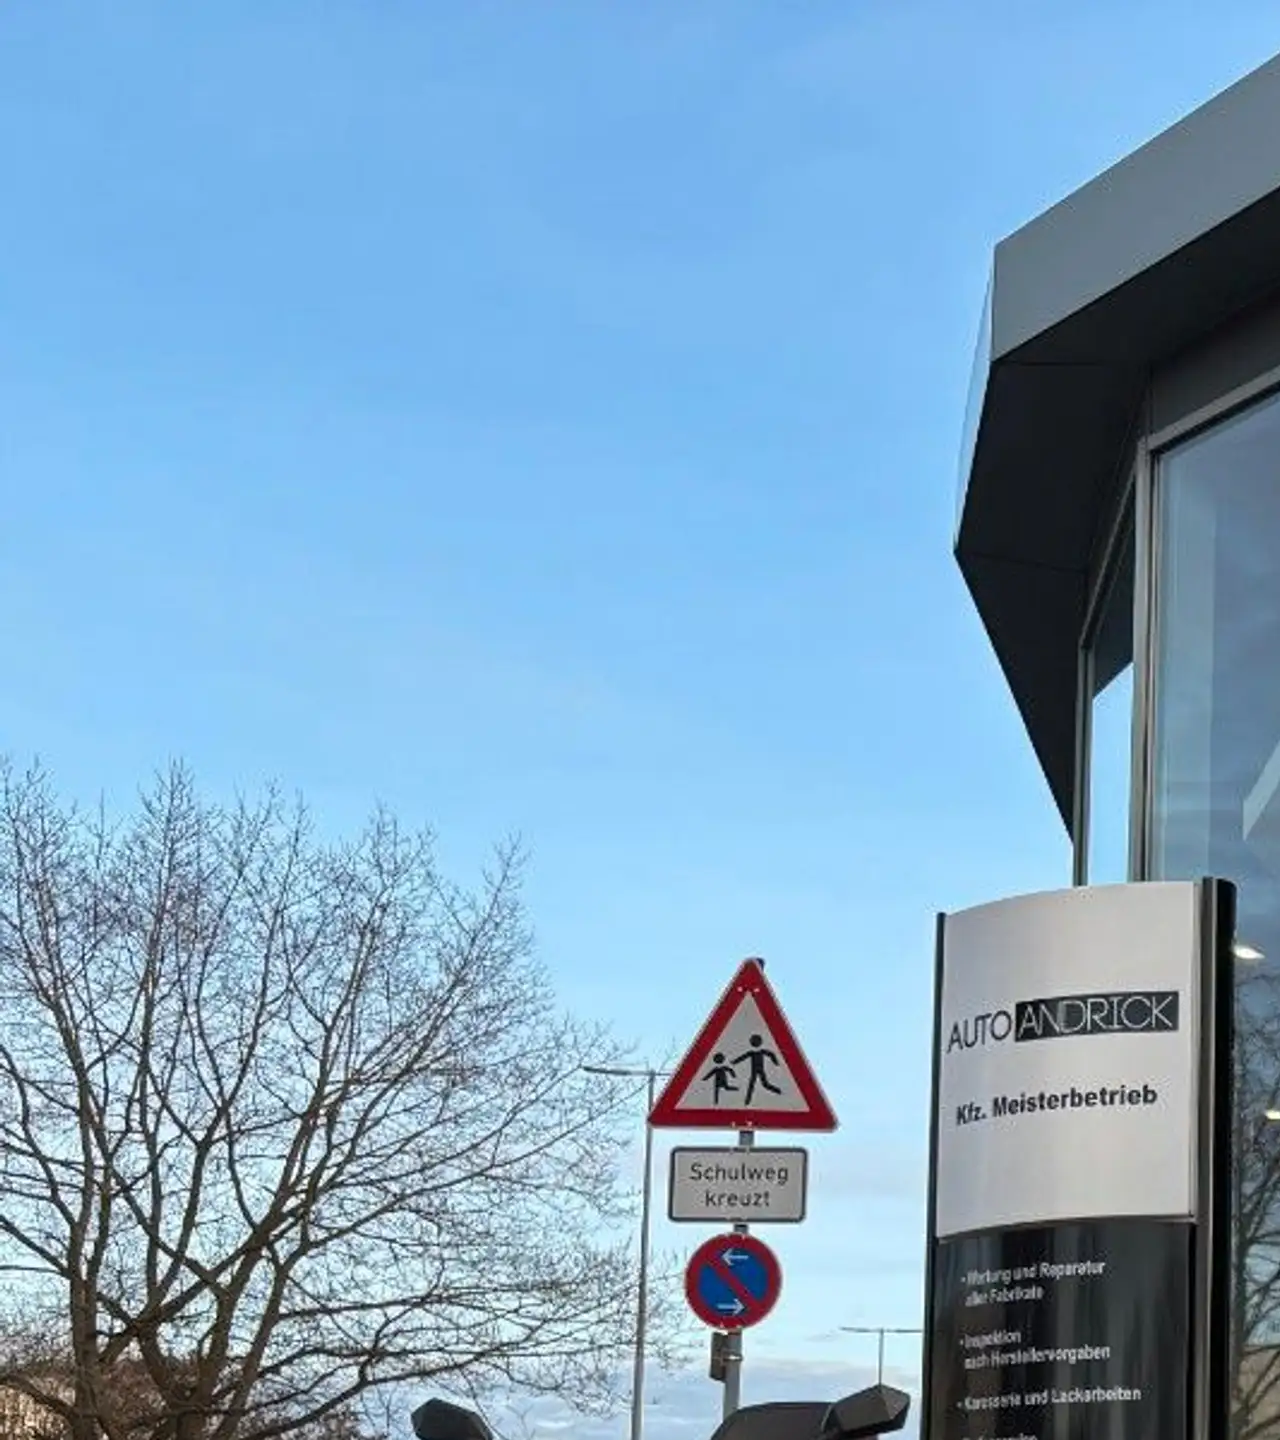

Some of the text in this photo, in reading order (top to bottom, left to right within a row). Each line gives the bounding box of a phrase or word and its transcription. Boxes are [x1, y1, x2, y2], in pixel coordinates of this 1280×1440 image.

[946, 995, 1175, 1054] AUTO ANDRICK
[956, 1084, 1158, 1126] Kfz. Meisterbetrieb
[690, 1162, 789, 1186] Schulweg
[705, 1189, 770, 1208] kreuzt
[1013, 1265, 1036, 1280] und
[1039, 1260, 1106, 1281] Reparatur
[1024, 1389, 1048, 1405] und
[1051, 1386, 1142, 1403] Lackarbeiten
